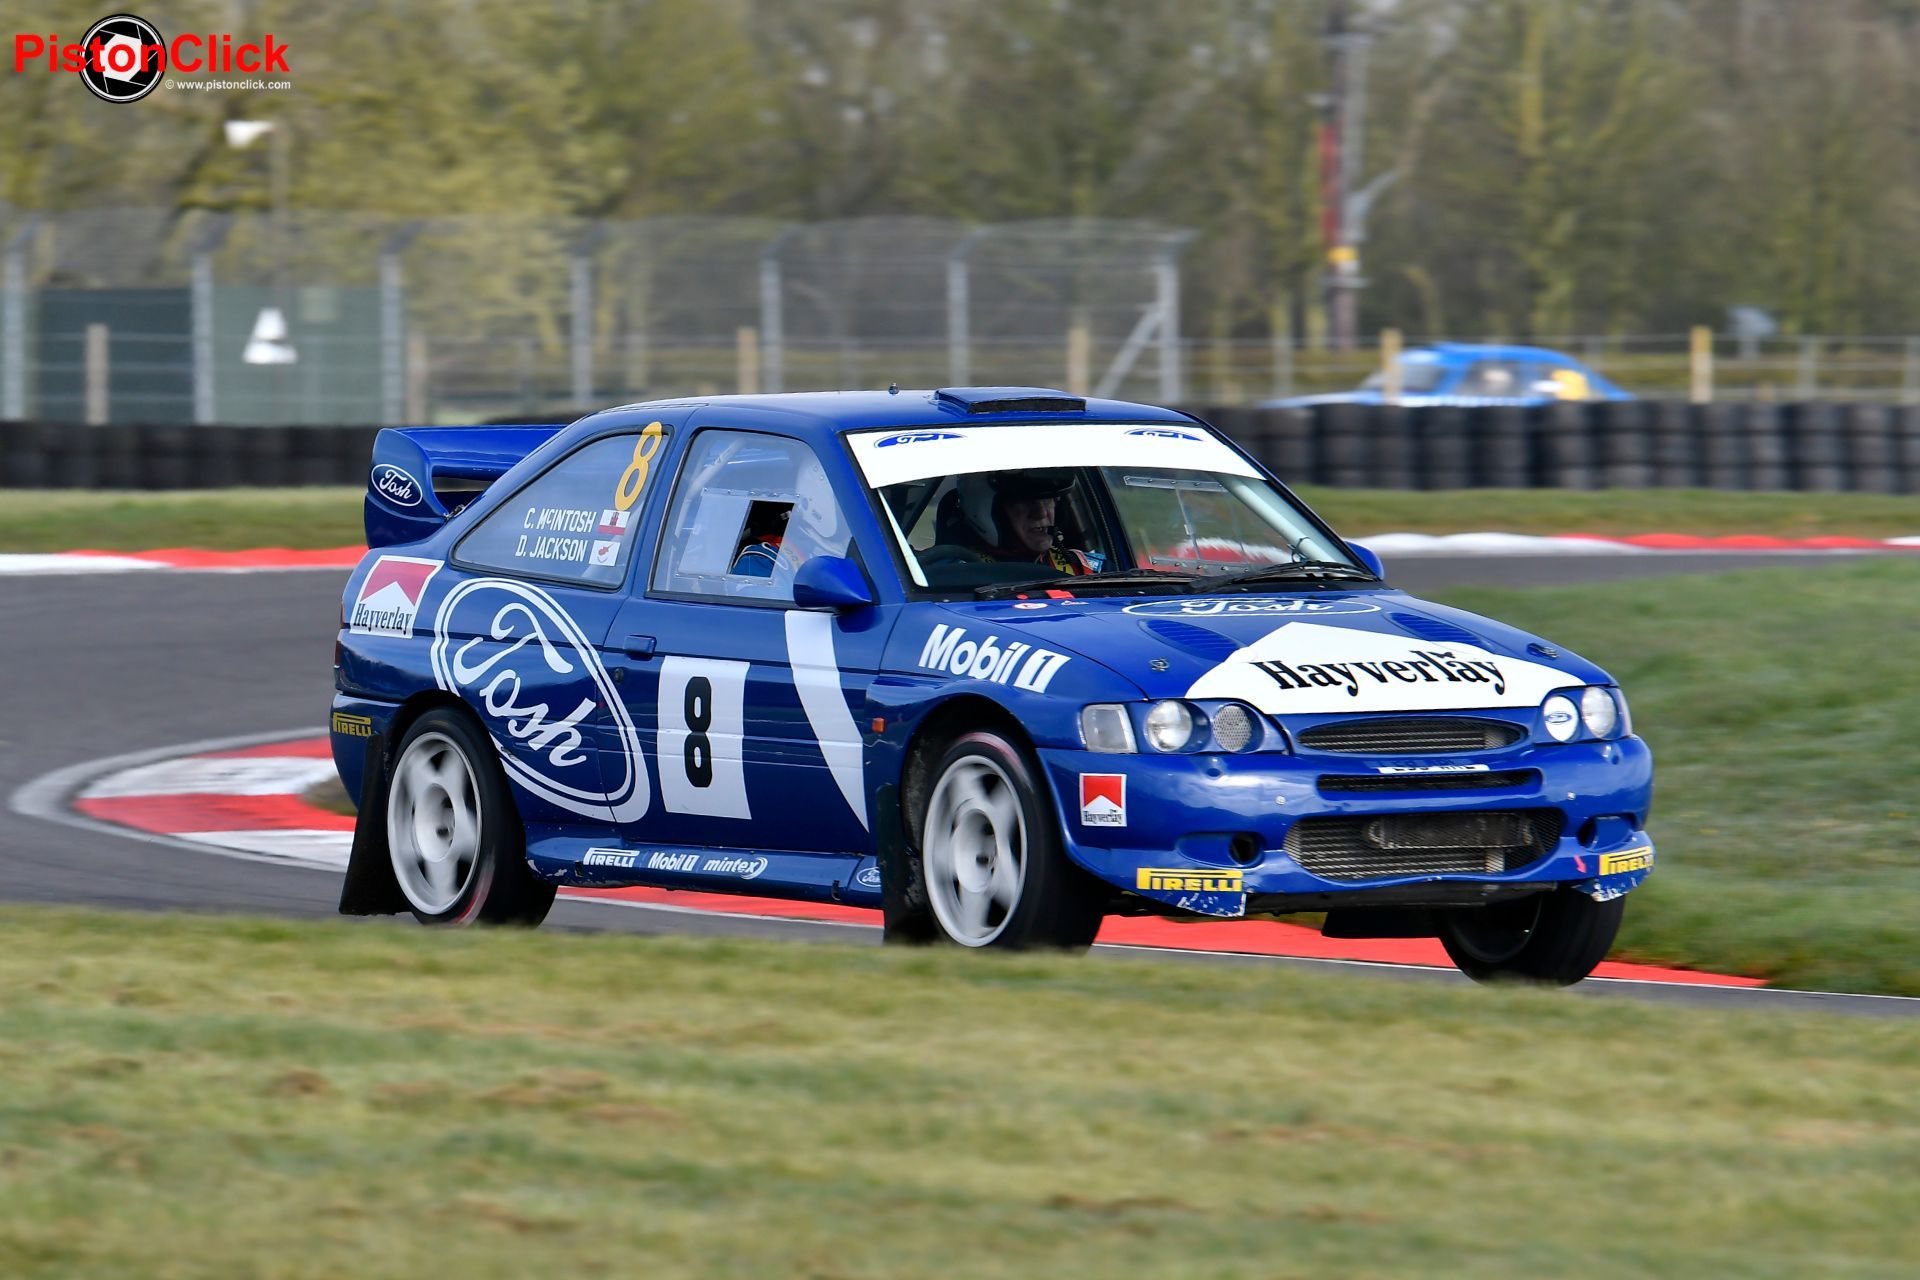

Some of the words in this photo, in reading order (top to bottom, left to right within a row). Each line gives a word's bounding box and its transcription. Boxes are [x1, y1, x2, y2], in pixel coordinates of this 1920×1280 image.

[614, 421, 663, 511] 8
[379, 469, 413, 499] Tosh
[523, 507, 536, 529] C.
[515, 534, 527, 557] D.
[529, 536, 588, 562] JACKSON
[353, 603, 413, 635] Hayverlay
[918, 623, 1032, 686] Mobil
[1013, 648, 1072, 694] 1
[453, 602, 597, 767] Tosh
[1249, 650, 1505, 697] Hayverlay
[332, 711, 372, 737] PIRELLI
[684, 676, 712, 788] 8
[583, 847, 640, 868] PIRELLI
[648, 851, 686, 871] Mobil
[703, 856, 761, 874] mintex
[1136, 867, 1243, 891] PIRELLI
